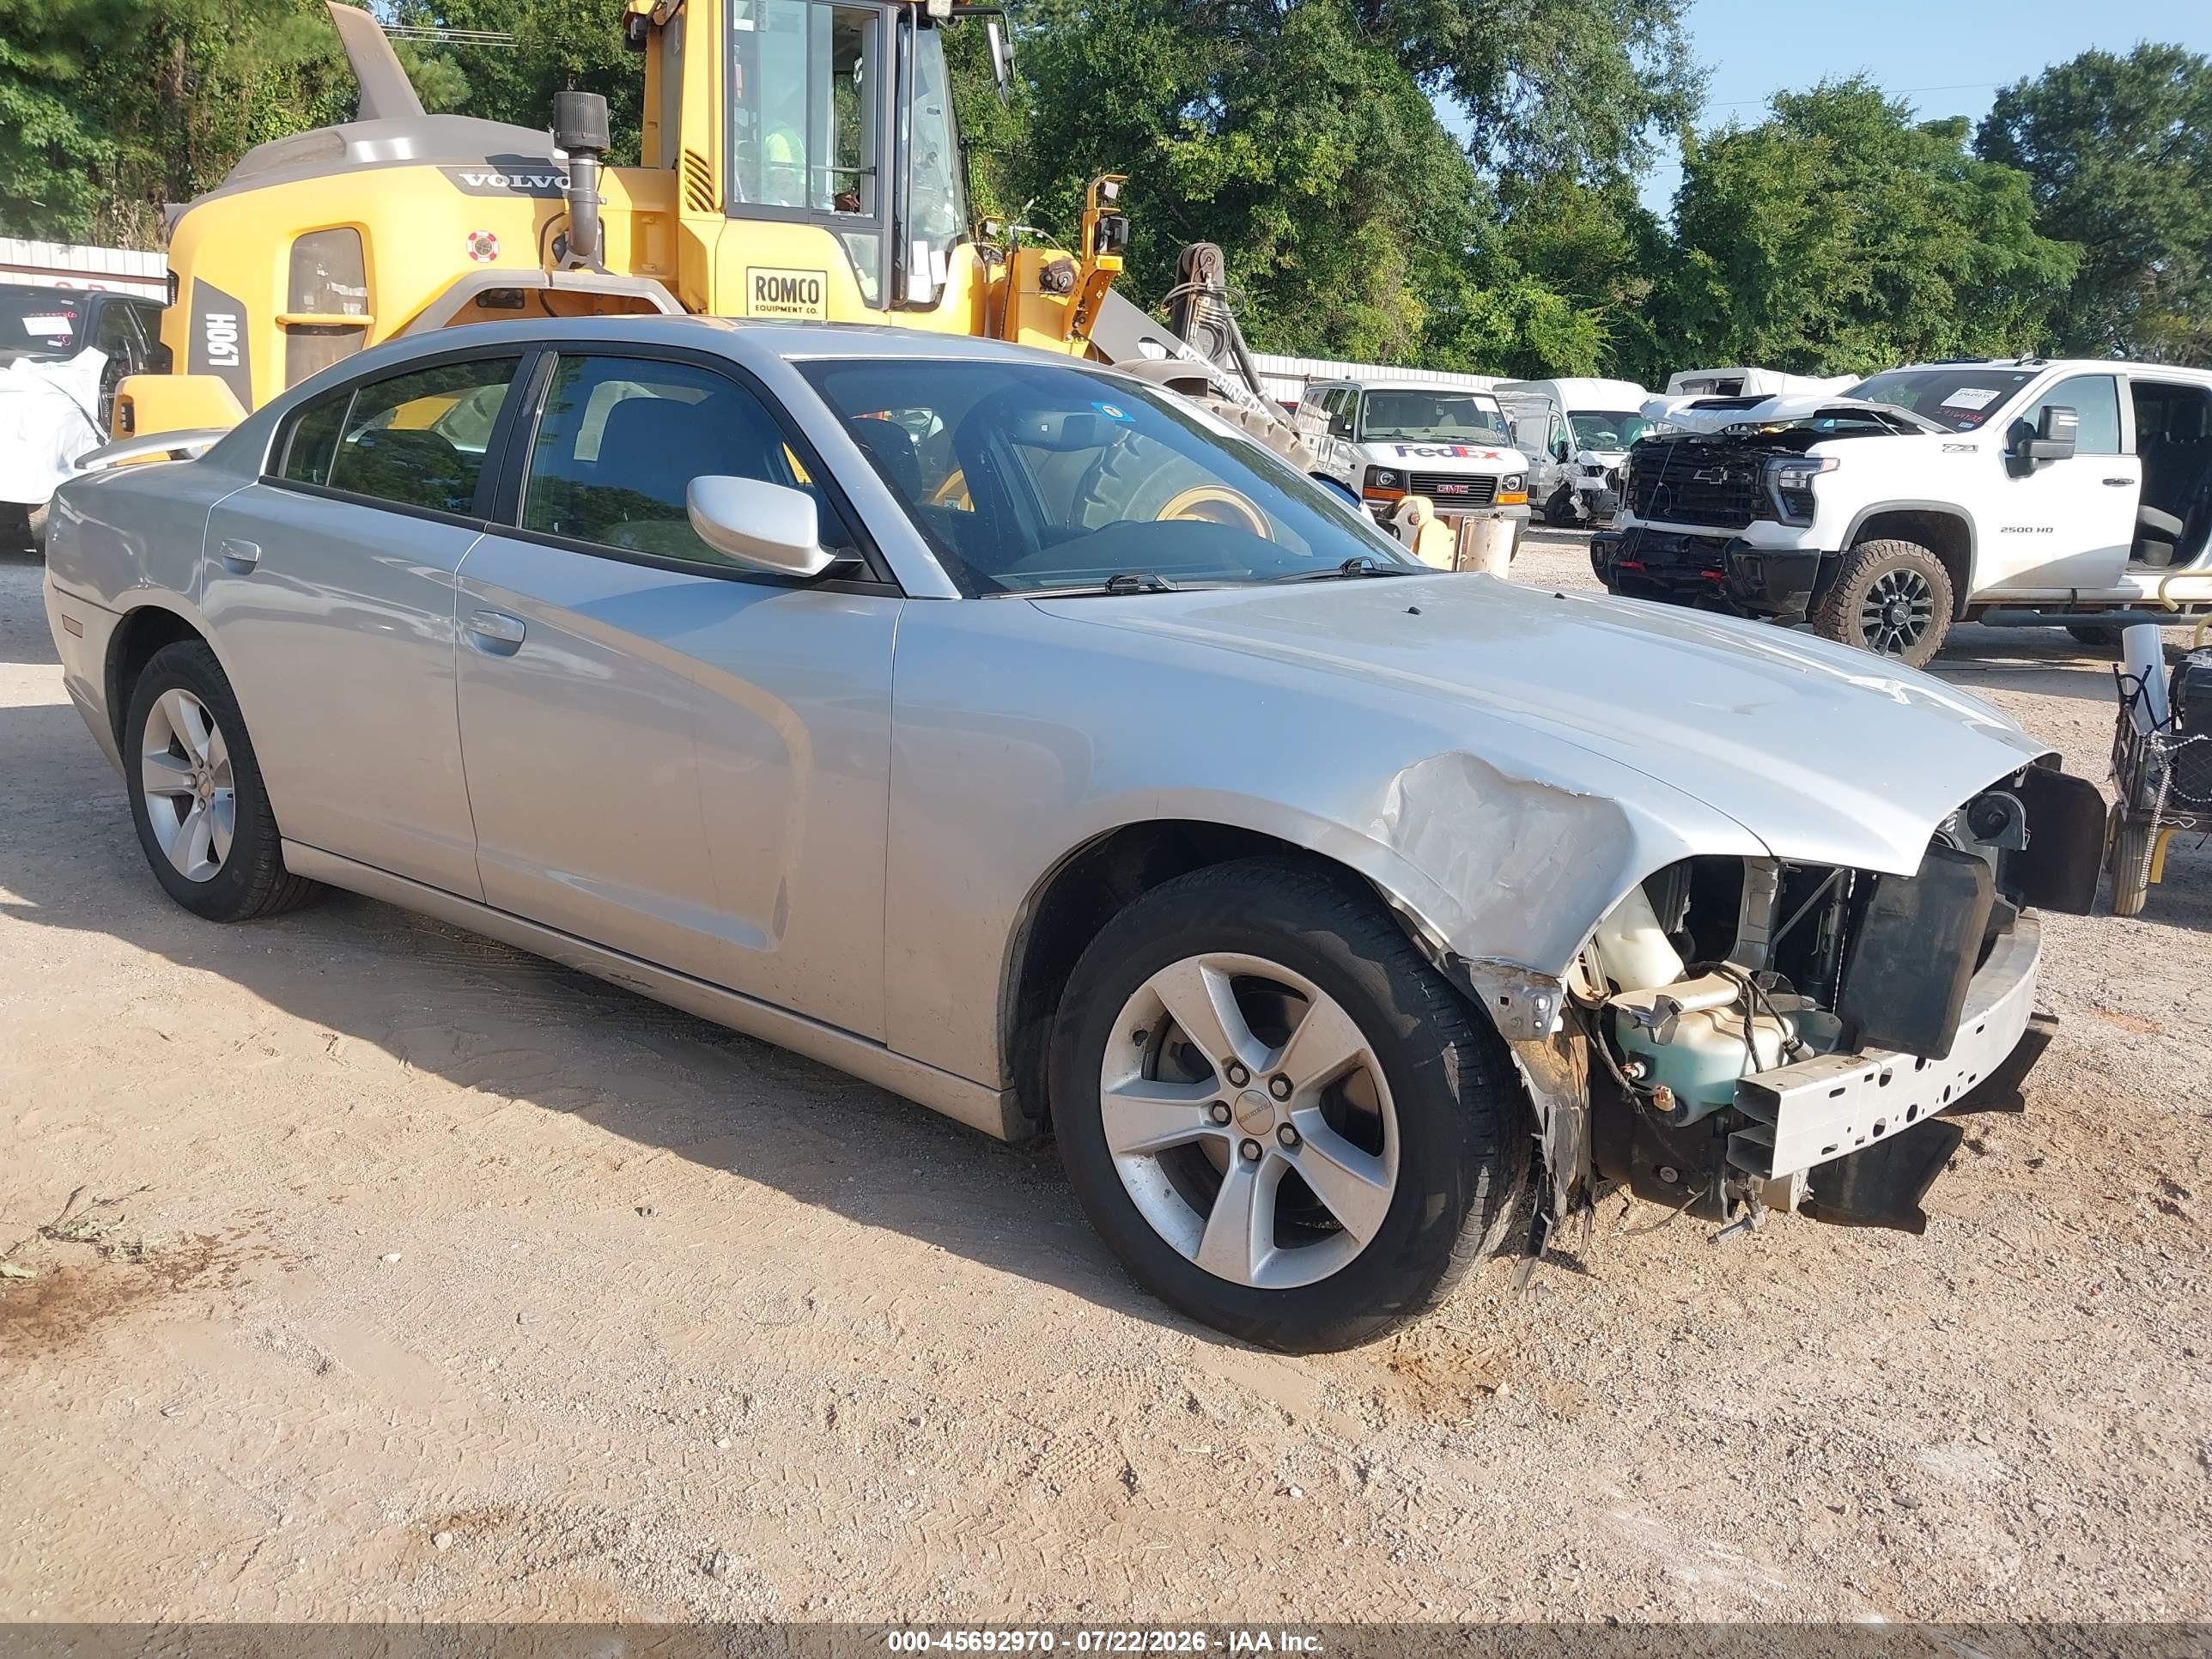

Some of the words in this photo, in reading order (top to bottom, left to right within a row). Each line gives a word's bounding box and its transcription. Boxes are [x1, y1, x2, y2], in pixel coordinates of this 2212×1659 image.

[459, 173, 571, 189] VOLVO
[756, 276, 819, 304] ROMCO
[756, 305, 803, 313] EQUIPMENT
[206, 313, 239, 366] L90H
[1394, 445, 1504, 460] FedEx
[1437, 483, 1469, 494] GMC
